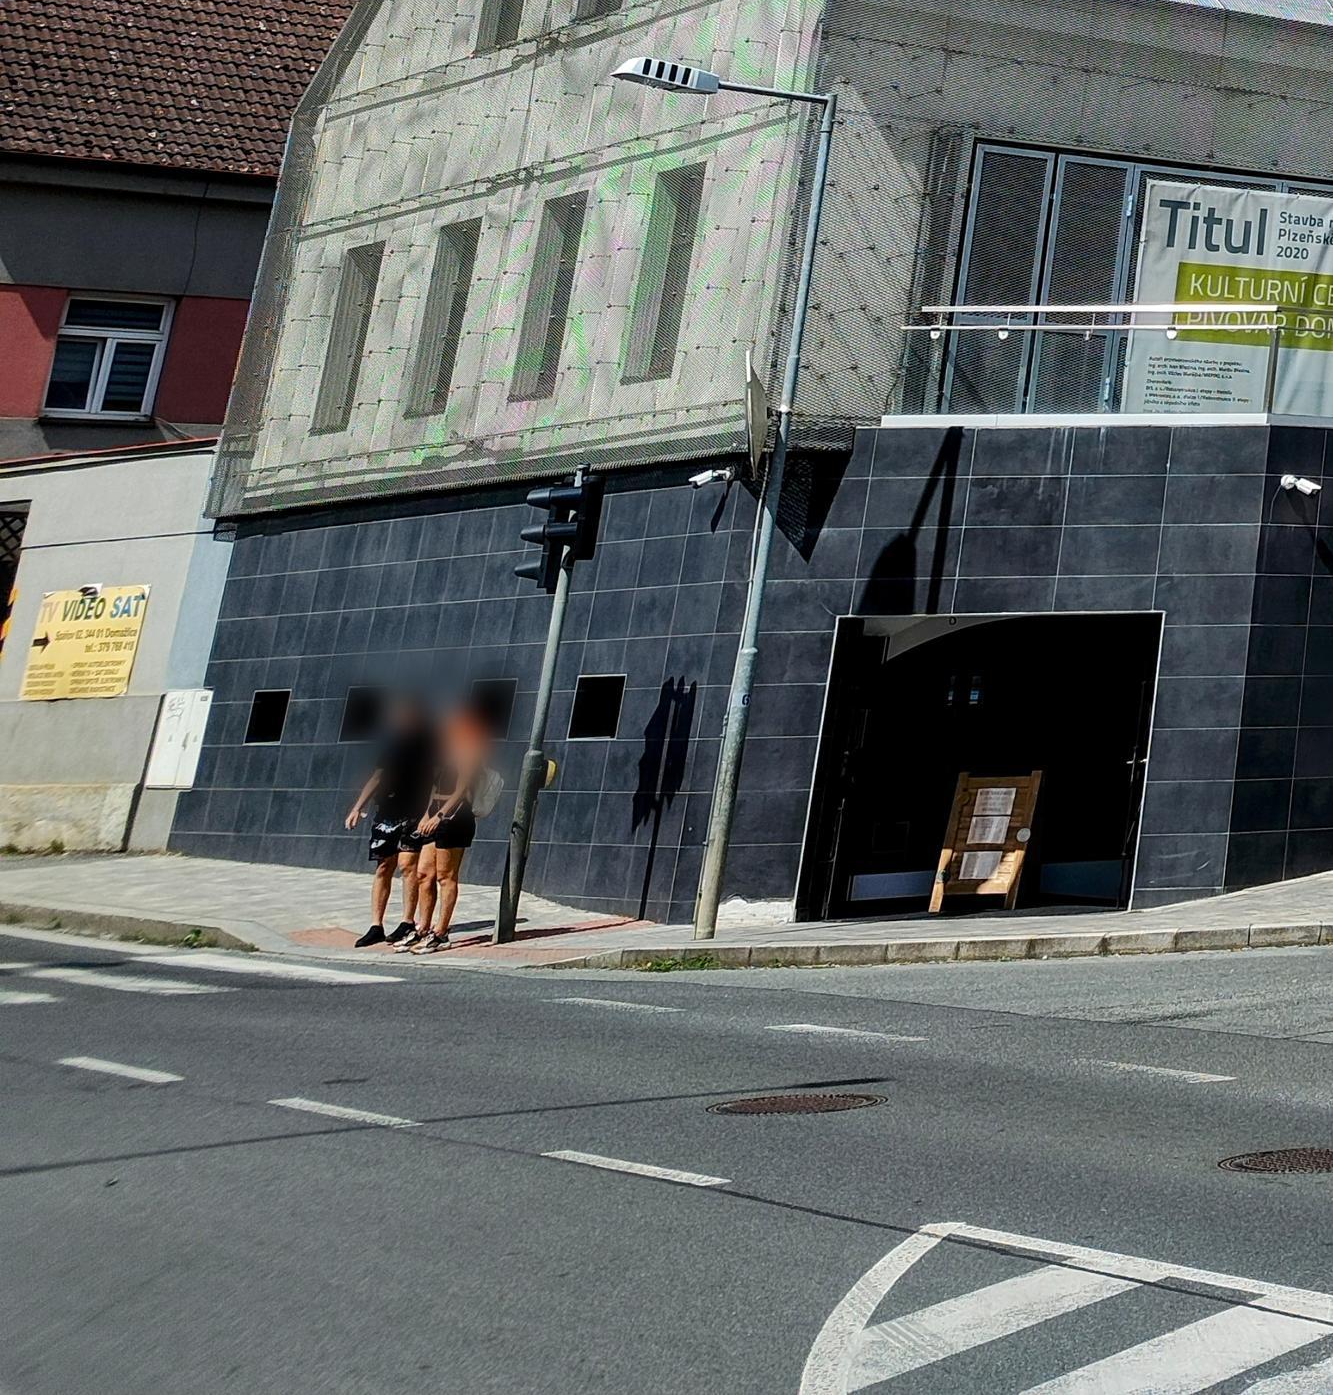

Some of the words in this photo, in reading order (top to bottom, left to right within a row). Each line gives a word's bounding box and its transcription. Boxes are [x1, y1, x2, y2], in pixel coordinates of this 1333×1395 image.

[1160, 199, 1268, 256] Titul
[1279, 211, 1324, 228] Stavba
[1276, 246, 1309, 260] 2020
[1190, 273, 1308, 304] KULTURNÍ
[1187, 311, 1287, 337] PIVOVAR
[41, 602, 60, 623] TV
[62, 597, 106, 622] VIDEO
[110, 595, 146, 619] SAT
